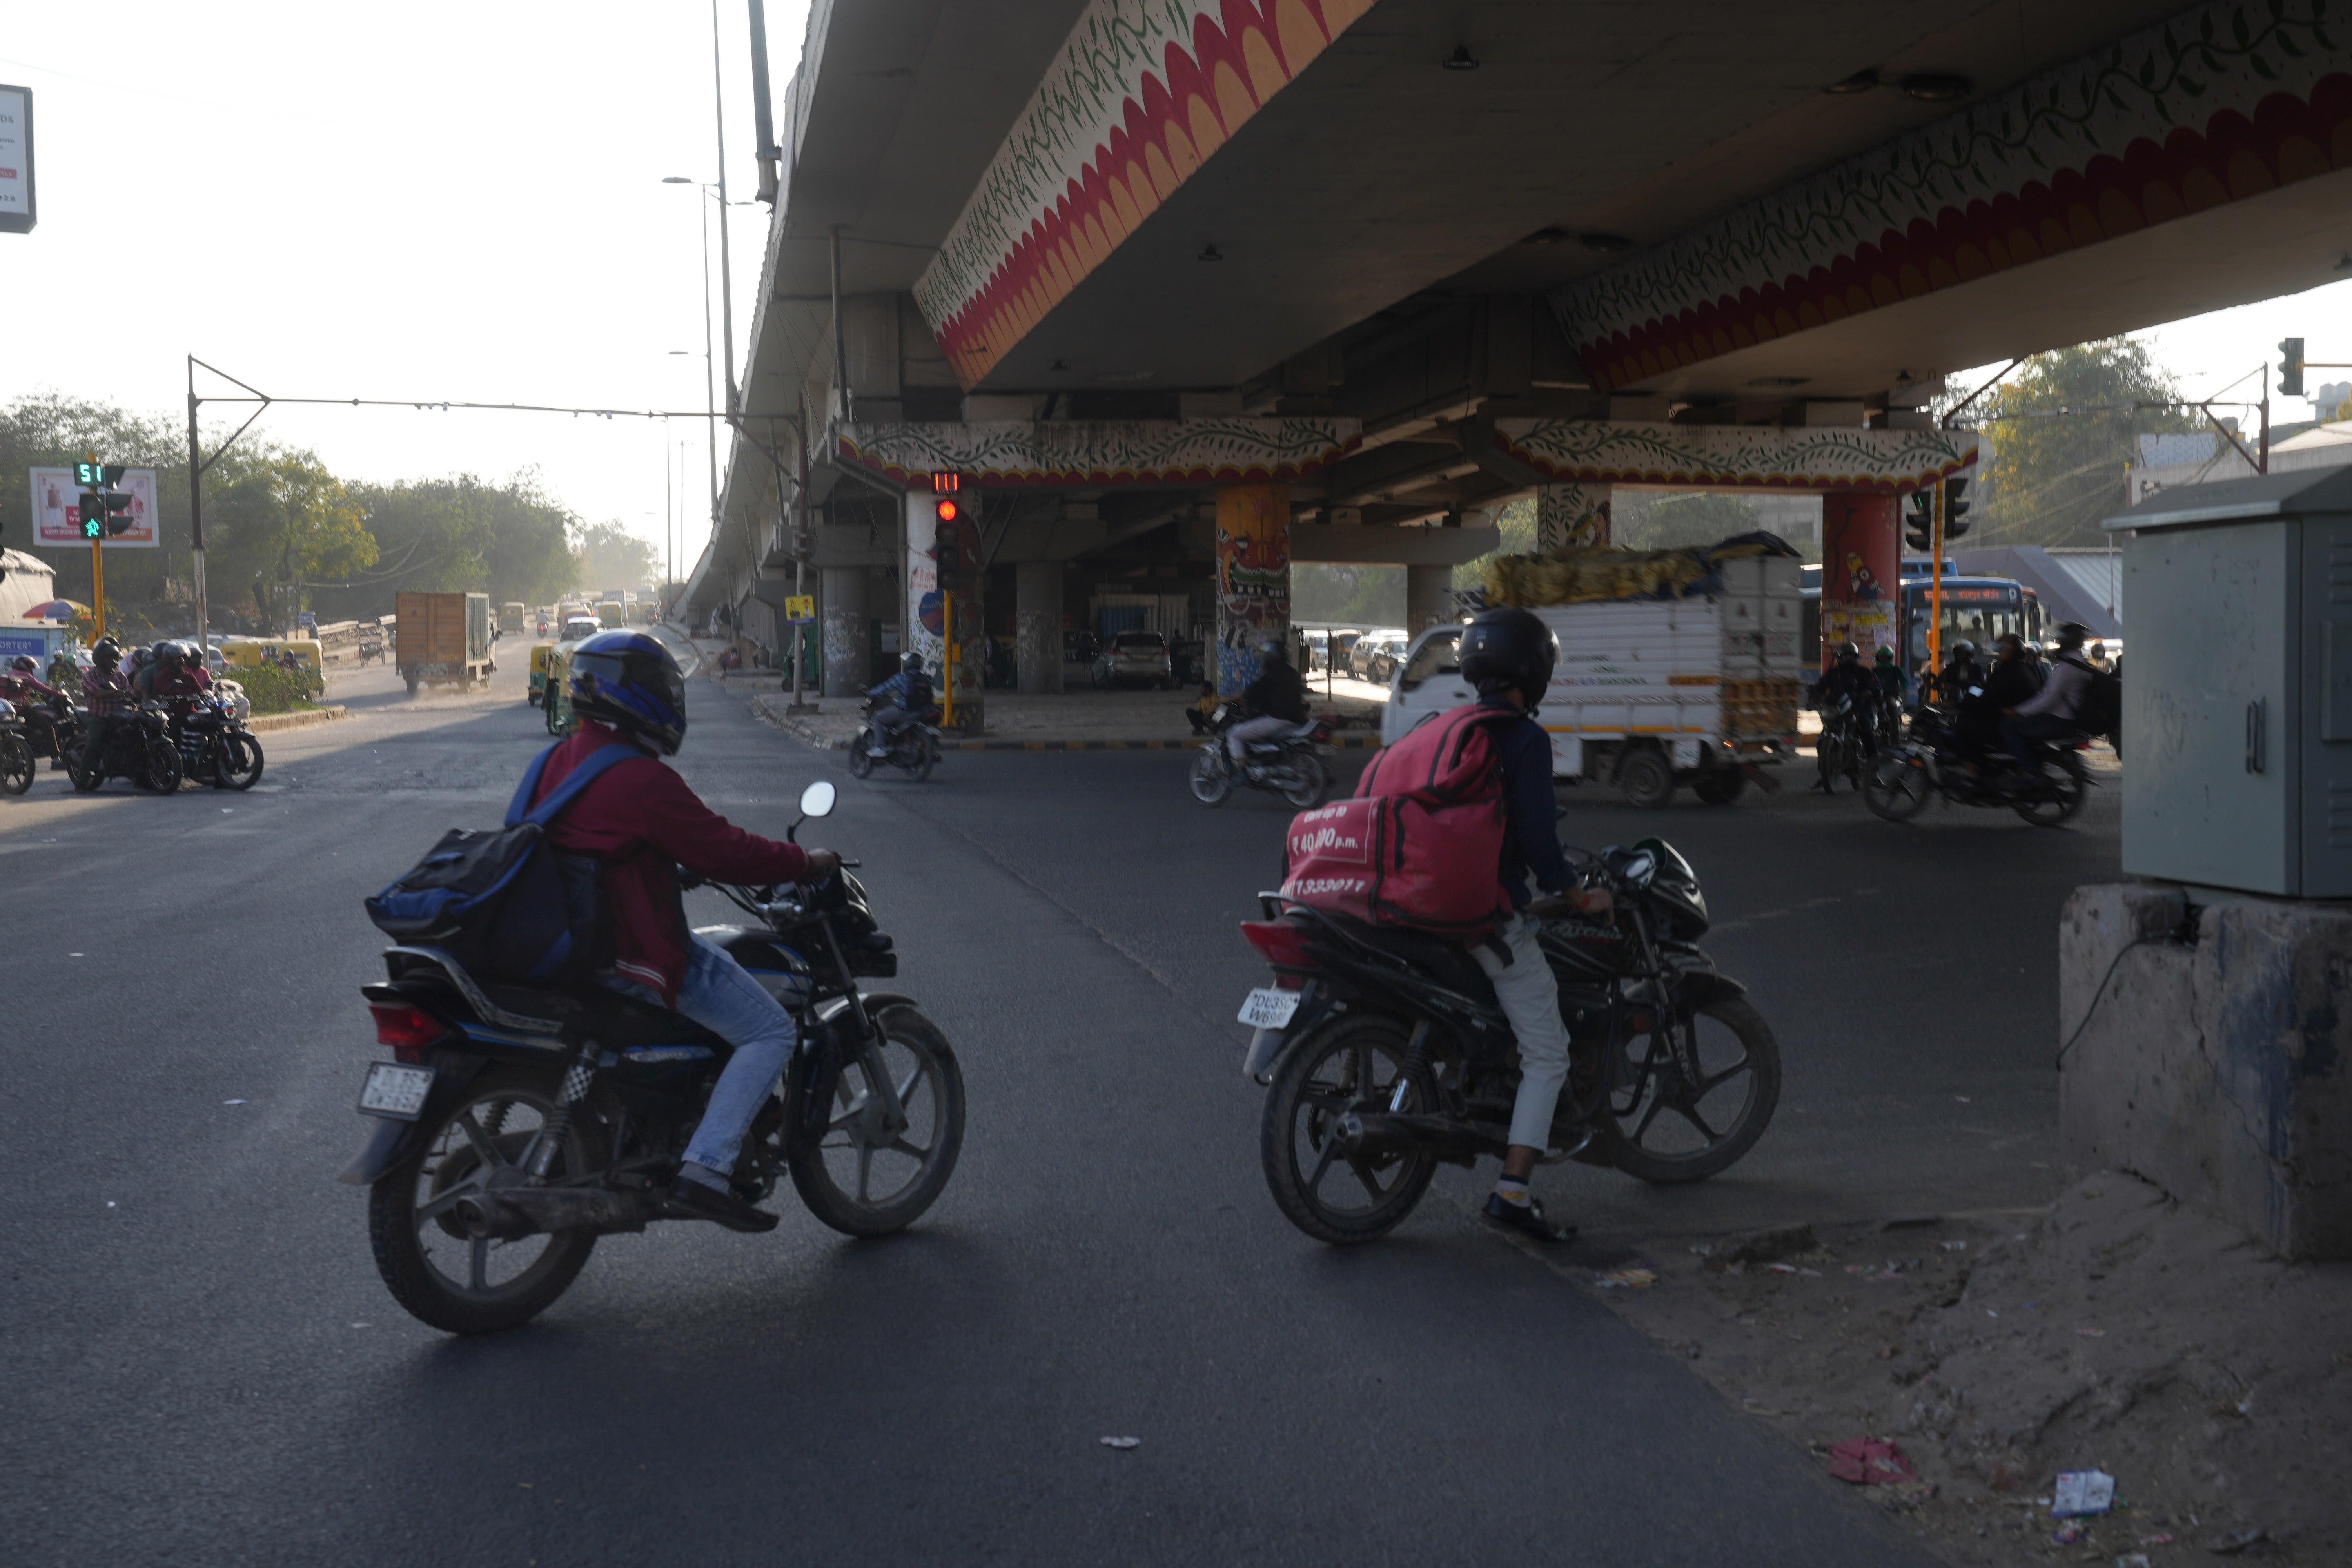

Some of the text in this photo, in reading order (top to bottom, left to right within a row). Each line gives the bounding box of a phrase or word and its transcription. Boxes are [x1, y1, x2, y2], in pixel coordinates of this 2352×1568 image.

[80, 464, 101, 482] 51
[935, 473, 958, 492] 111
[1335, 835, 1358, 850] p.m.
